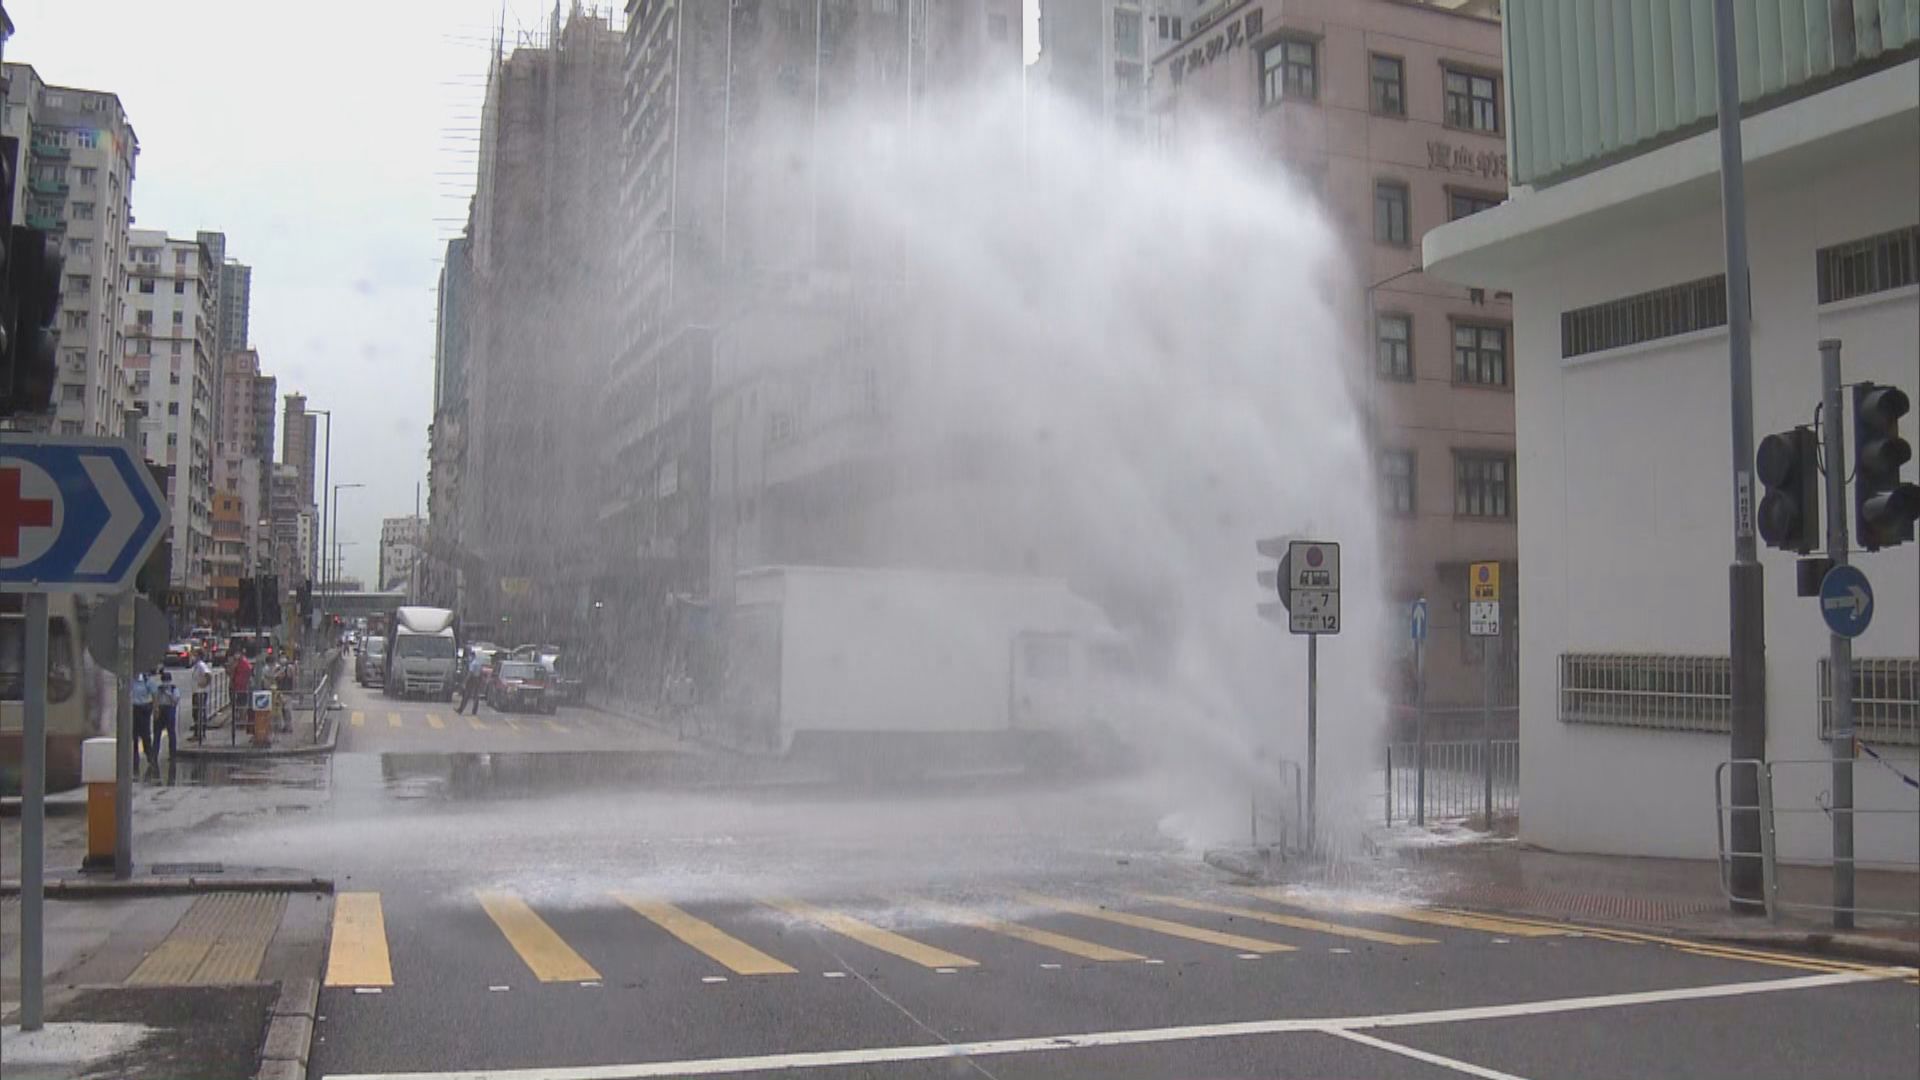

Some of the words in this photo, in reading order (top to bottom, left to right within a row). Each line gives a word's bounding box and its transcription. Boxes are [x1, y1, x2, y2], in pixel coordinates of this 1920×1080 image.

[1321, 593, 1329, 607] 7
[1488, 603, 1494, 615] 7
[1322, 615, 1336, 630] 12
[1488, 621, 1498, 633] 12
